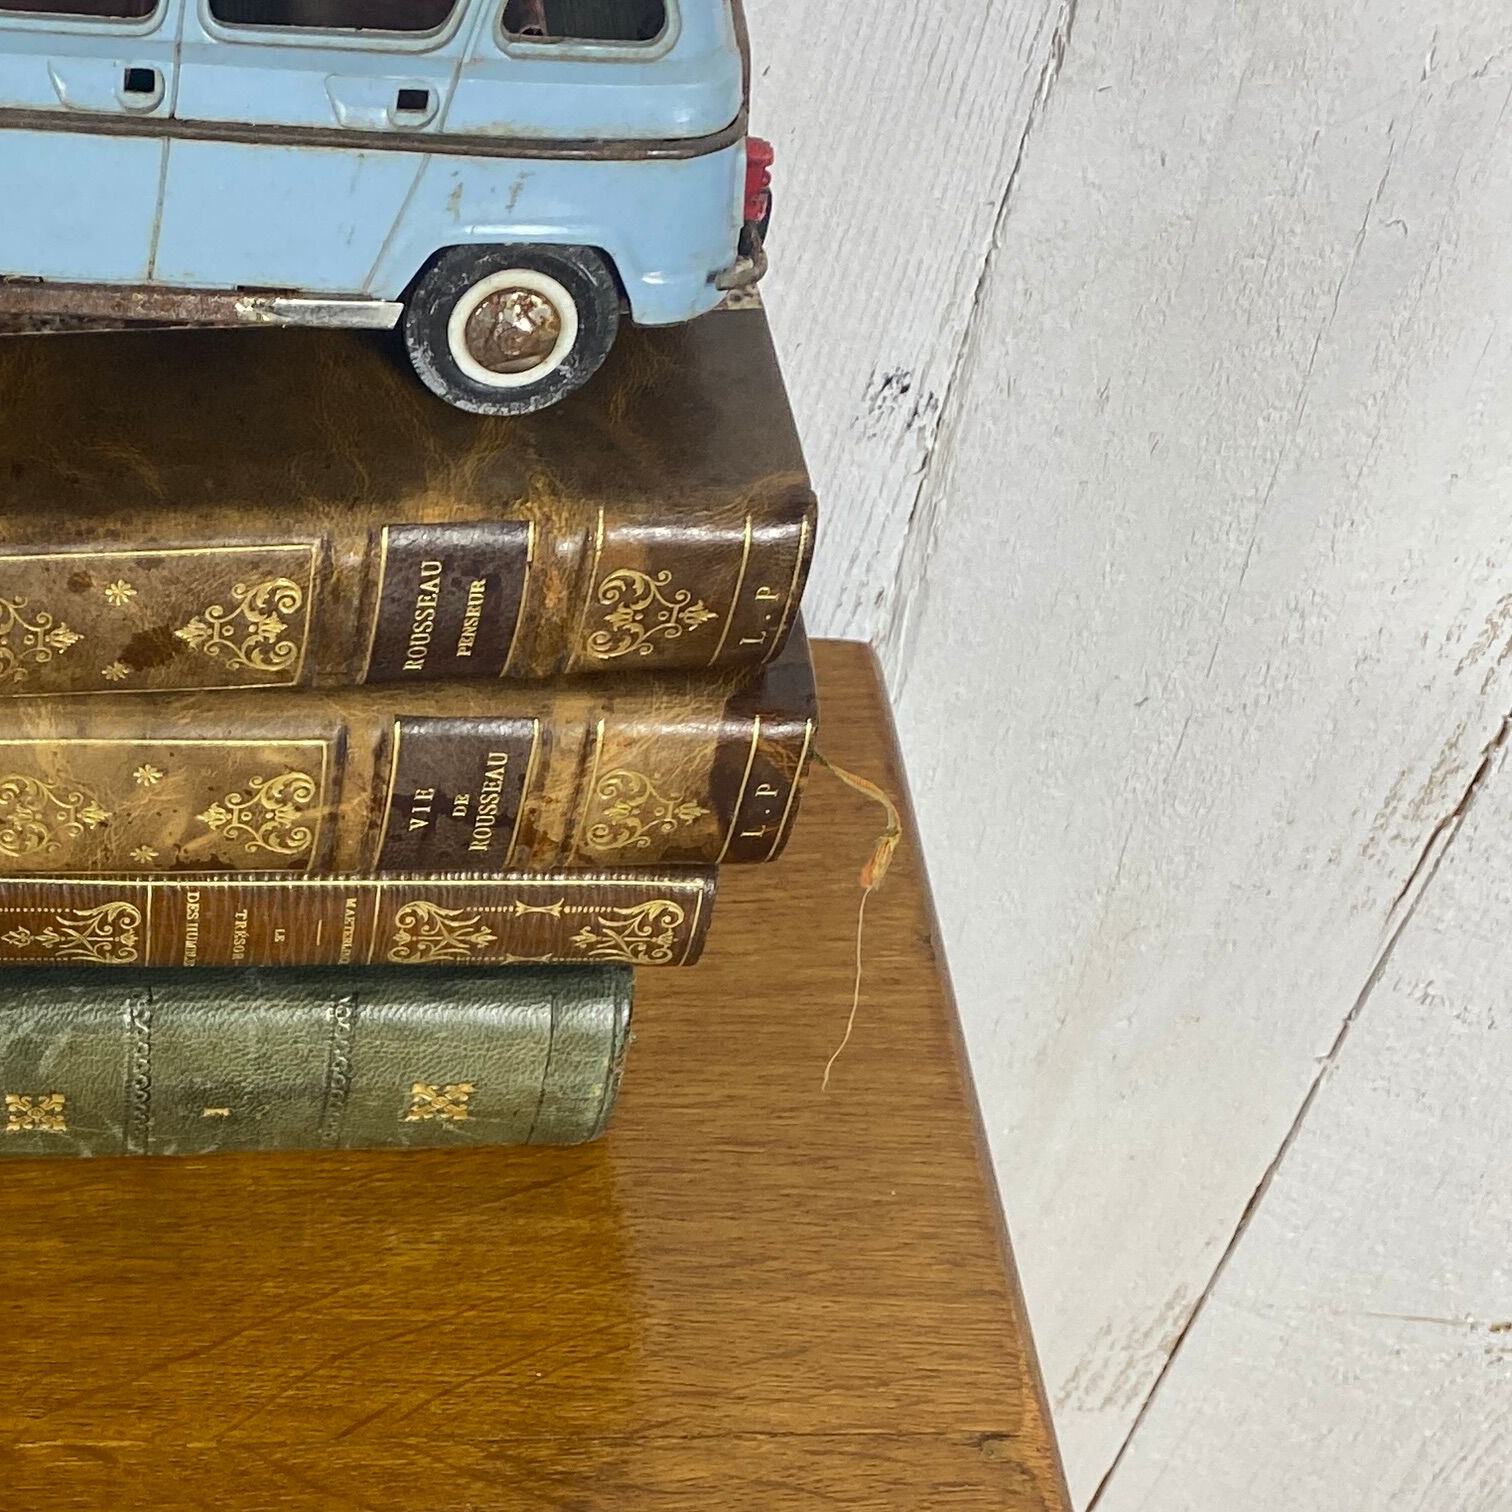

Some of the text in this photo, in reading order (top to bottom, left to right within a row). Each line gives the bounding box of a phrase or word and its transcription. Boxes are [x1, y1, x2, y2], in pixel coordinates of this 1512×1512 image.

[402, 560, 442, 670] ROUSSEAU
[456, 578, 487, 656] PENSEUR
[408, 787, 435, 832] VIE
[452, 793, 470, 817] DE
[468, 752, 508, 851] ROUSSEAU
[187, 890, 200, 920] DES
[274, 928, 285, 943] LE
